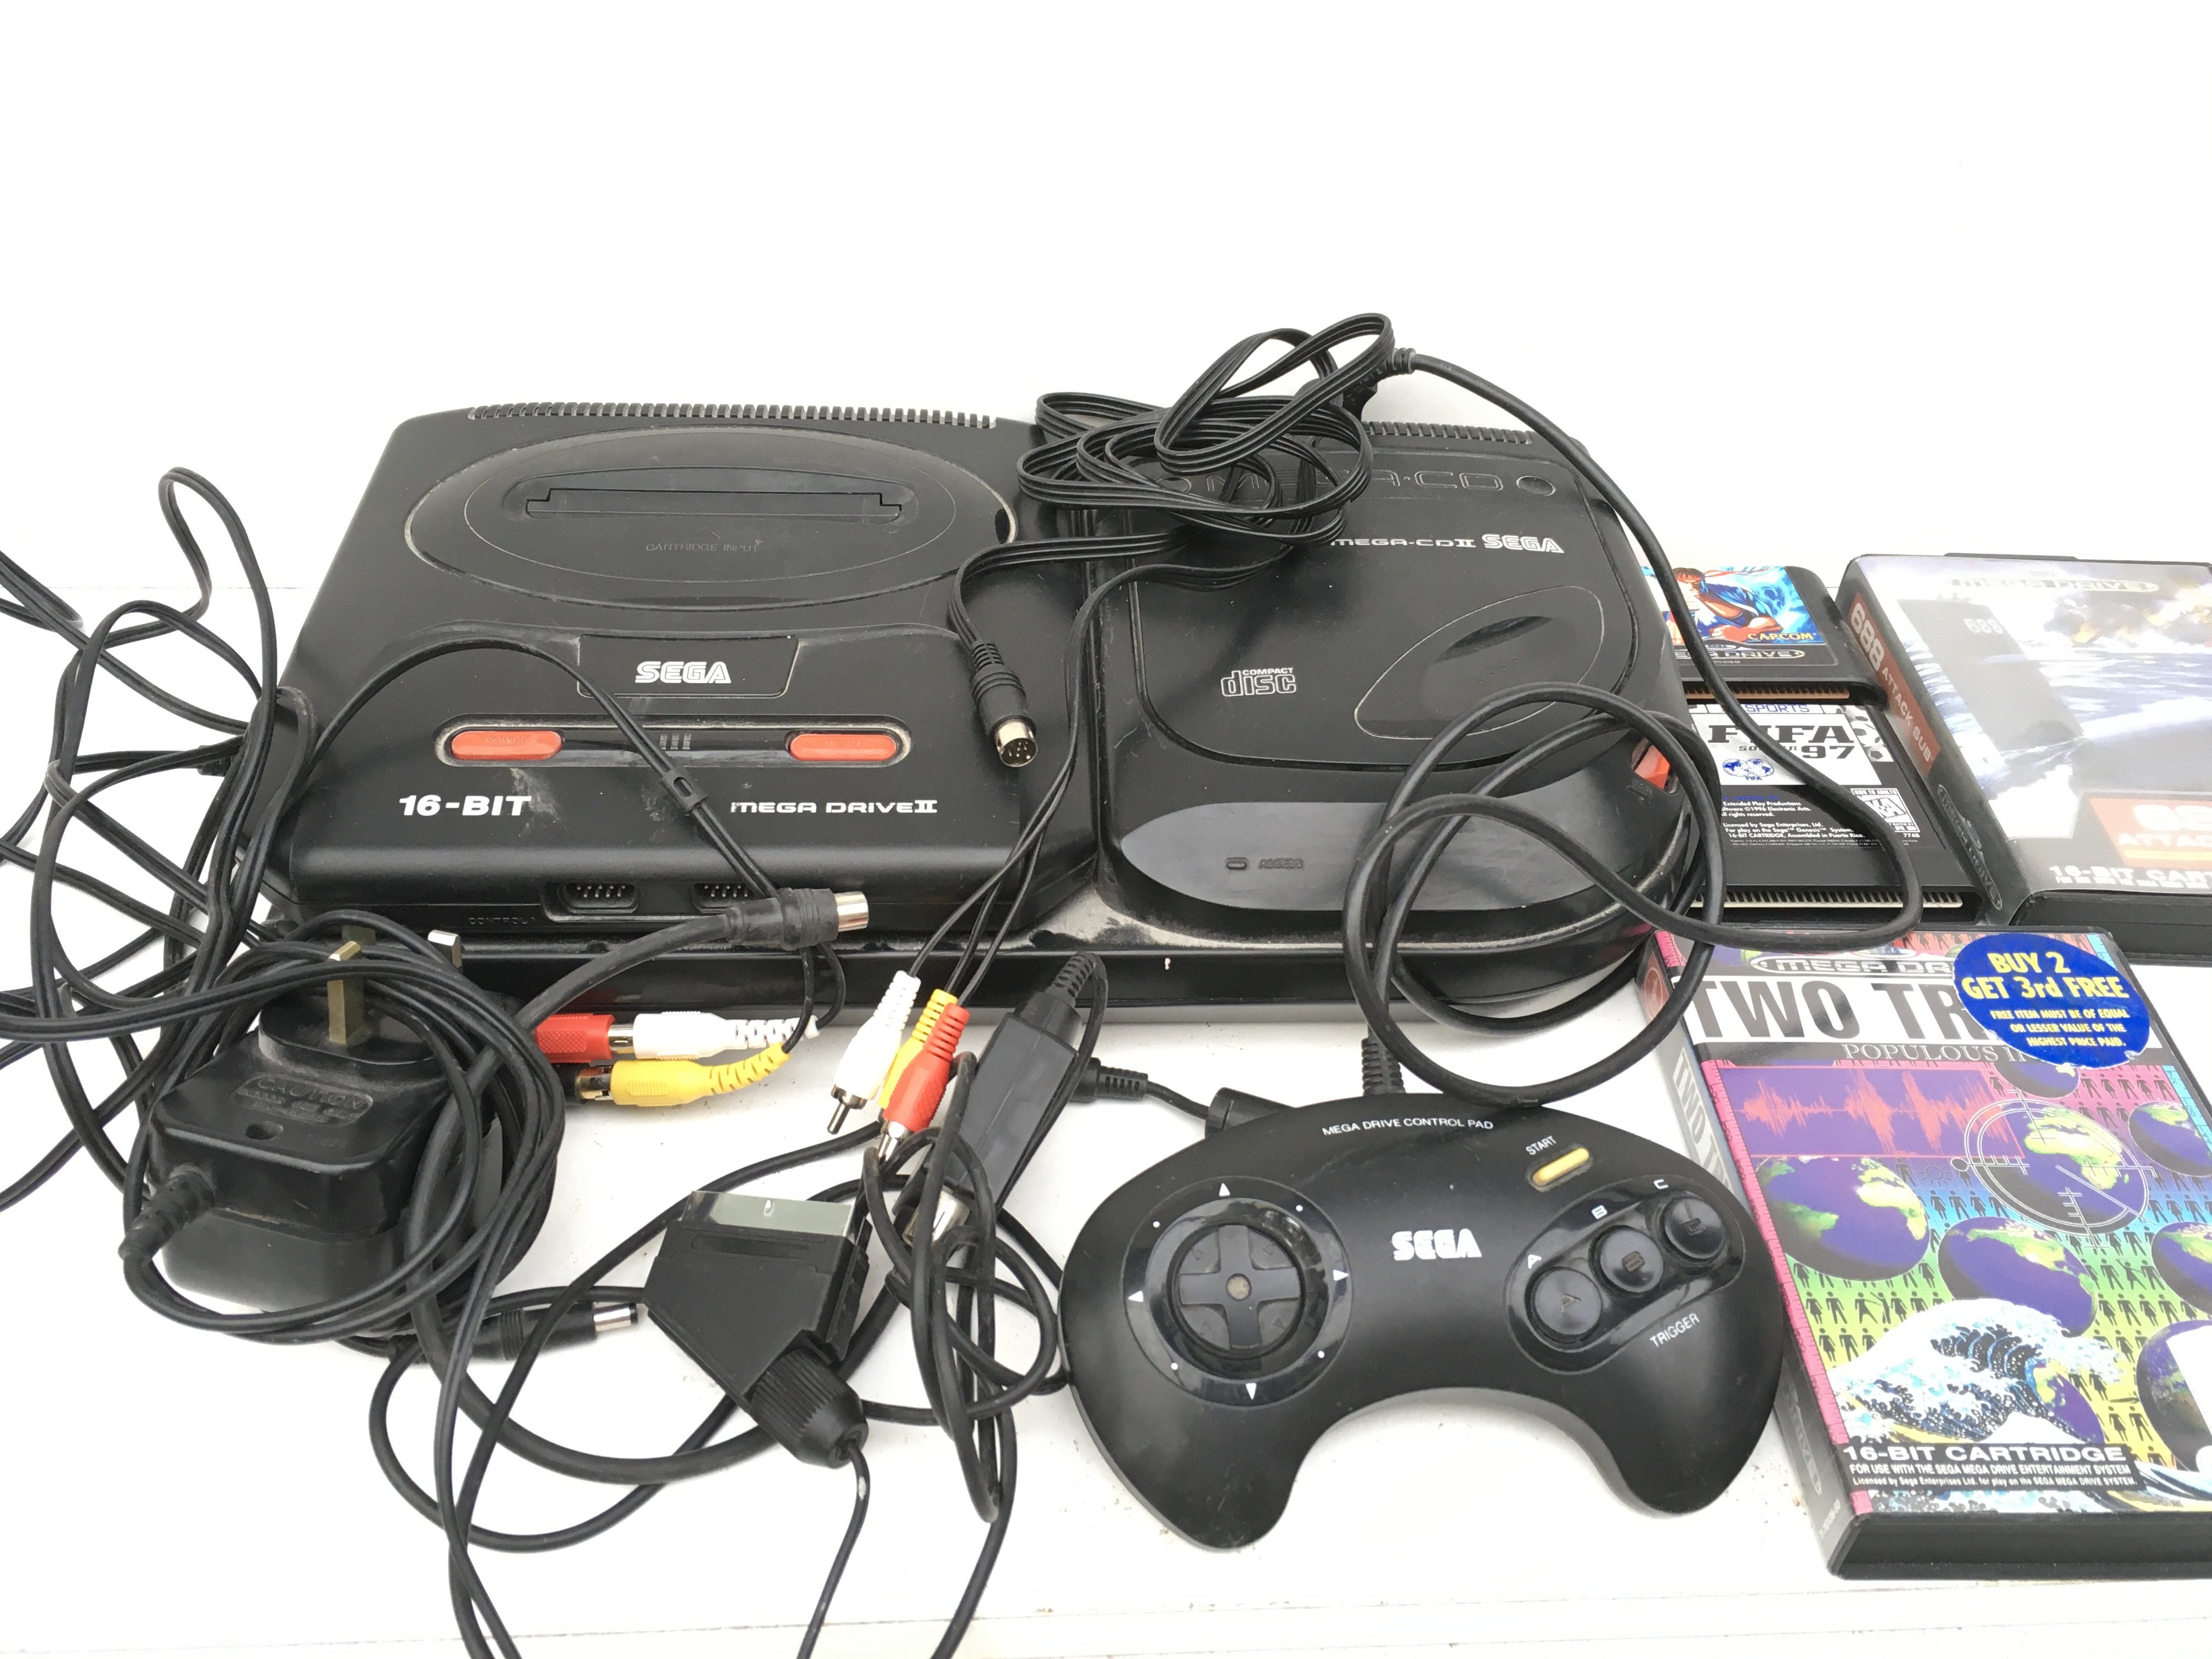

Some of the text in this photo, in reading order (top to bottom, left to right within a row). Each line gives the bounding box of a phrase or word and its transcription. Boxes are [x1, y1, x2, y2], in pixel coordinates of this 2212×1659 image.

[646, 543, 758, 552] CARTRIDGE INPUT
[1482, 534, 1565, 554] SEGA
[1747, 633, 1814, 641] CAPCOM
[1850, 603, 1884, 671] 688
[1882, 667, 1914, 726] ATTACK
[635, 661, 732, 684] SEGA
[1221, 670, 1297, 697] disc
[1745, 704, 1810, 713] SPORTS
[1801, 745, 1855, 759] 97
[399, 795, 532, 816] 16-BIT
[731, 802, 817, 814] MEGA
[2049, 865, 2134, 879] 16-BIT
[1776, 960, 1887, 973] MEGA
[1987, 952, 2071, 973] BUY 2
[1961, 976, 2130, 999] GET 3rd FREE
[1694, 980, 1861, 1040] TWO
[1990, 1009, 2130, 1019] FREE ITEM MUST BE OF EQUAL
[2010, 1023, 2127, 1033] OR LESSER VALUE OF THE
[2026, 1037, 2127, 1046] HIGHEST PRICE PAID.
[1841, 1043, 1999, 1062] POPULOUS
[1322, 1118, 1494, 1136] MEGA DRIVE CONTROL PAD
[1526, 1135, 1556, 1155] START
[1592, 1205, 1607, 1220] B
[1391, 1229, 1482, 1261] SEGA
[1528, 1254, 1542, 1268] A
[1649, 1312, 1700, 1347] TRIGGER
[1843, 1446, 2126, 1462] 16-BIT CARTRIDGE
[1849, 1464, 2131, 1475] FOR USE WITH THE SEGA MEGA DRIVE ENTERTAINMENT SYSTEM
[1853, 1477, 1887, 1485] Licensed
[1889, 1477, 1898, 1487] by
[1900, 1477, 1918, 1487] Sega
[1920, 1477, 1962, 1487] Enterprises
[1979, 1477, 1989, 1485] for
[1991, 1478, 2007, 1487] play
[2033, 1477, 2055, 1485] SEGA
[2057, 1477, 2079, 1485] MEGA
[2079, 1477, 2104, 1486] DRIVE
[2104, 1477, 2138, 1486] SYSTEM.
